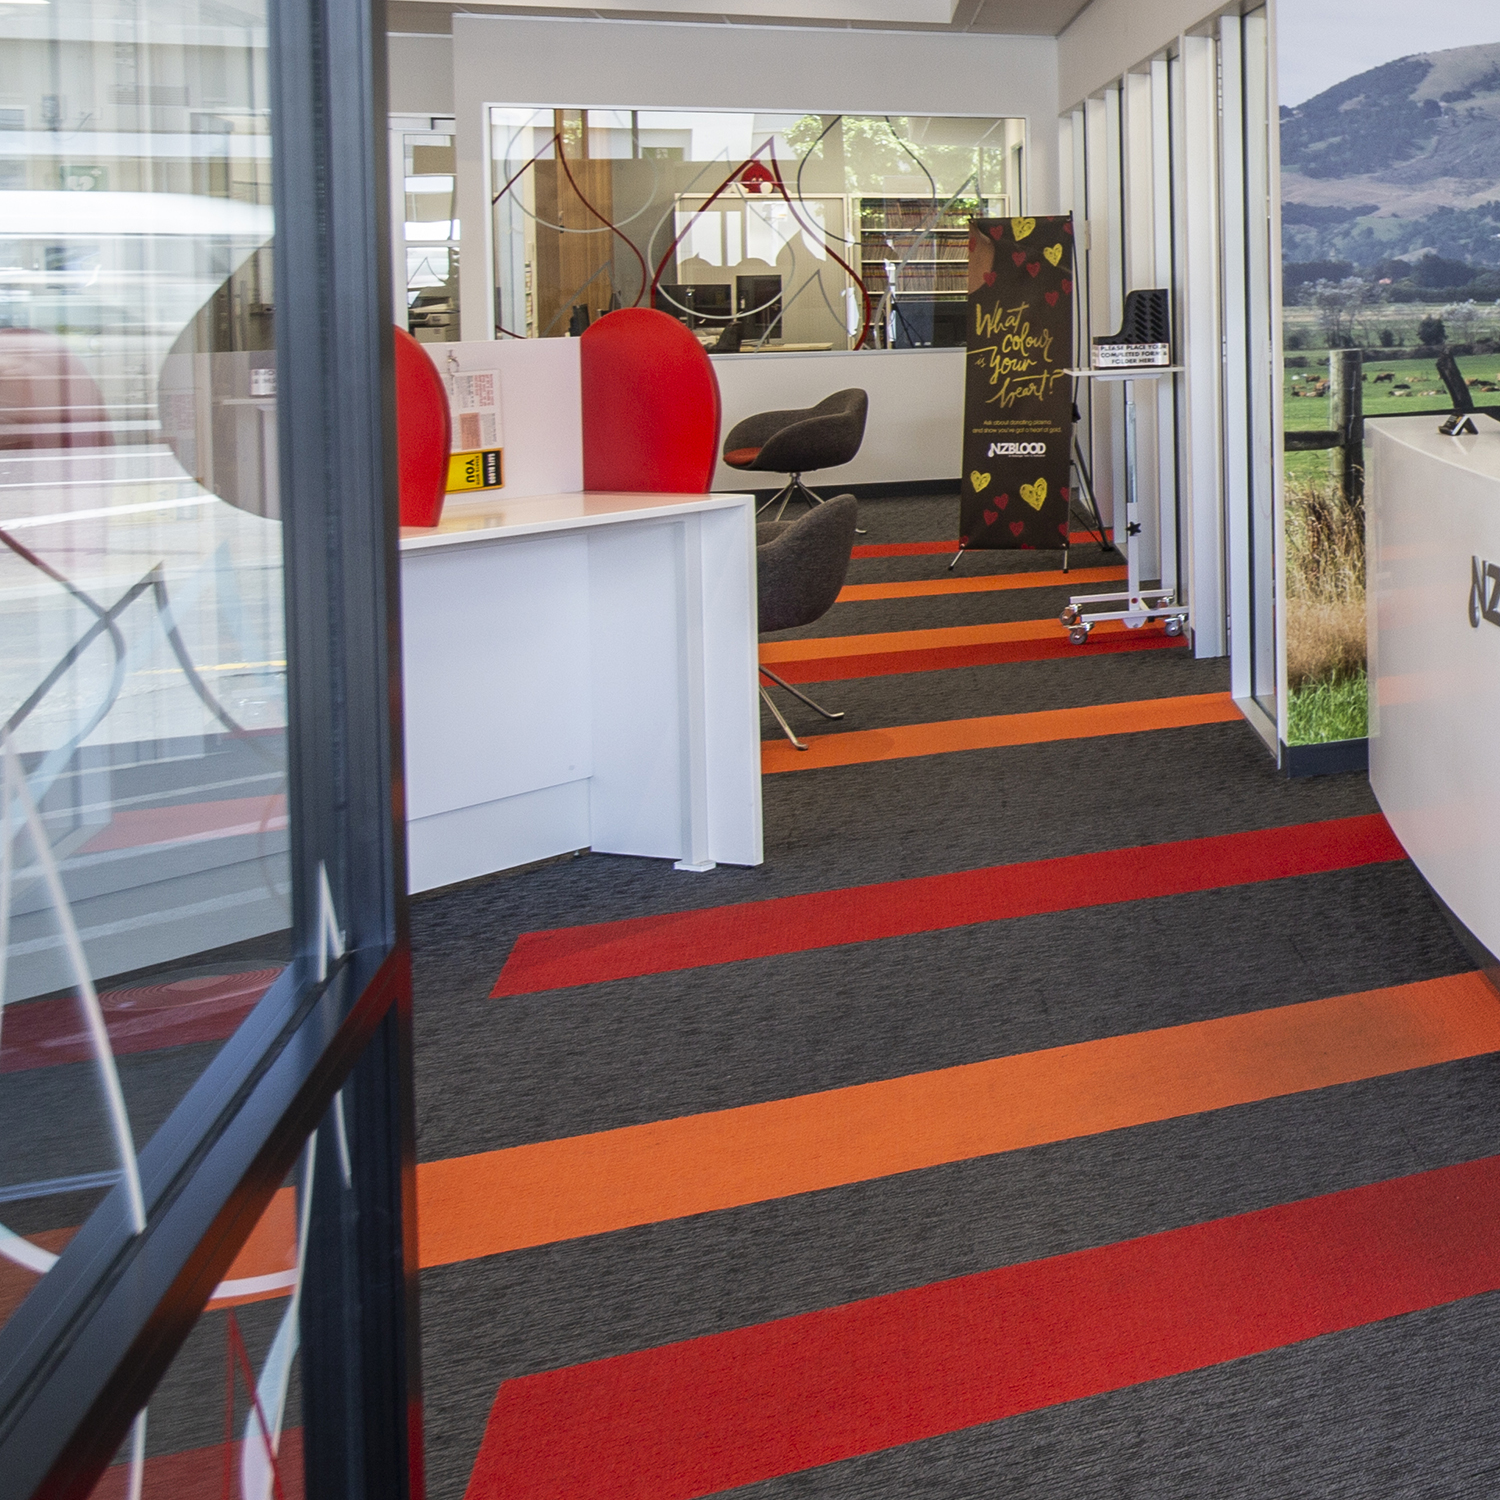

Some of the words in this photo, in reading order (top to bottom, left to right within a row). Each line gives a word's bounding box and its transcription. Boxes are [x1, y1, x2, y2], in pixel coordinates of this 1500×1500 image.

[976, 300, 1029, 338] What
[1002, 322, 1053, 362] colour
[487, 453, 496, 466] SAFE
[987, 442, 1046, 457] NZBLOOD
[465, 459, 475, 483] YOU
[487, 467, 497, 484] BLOOD
